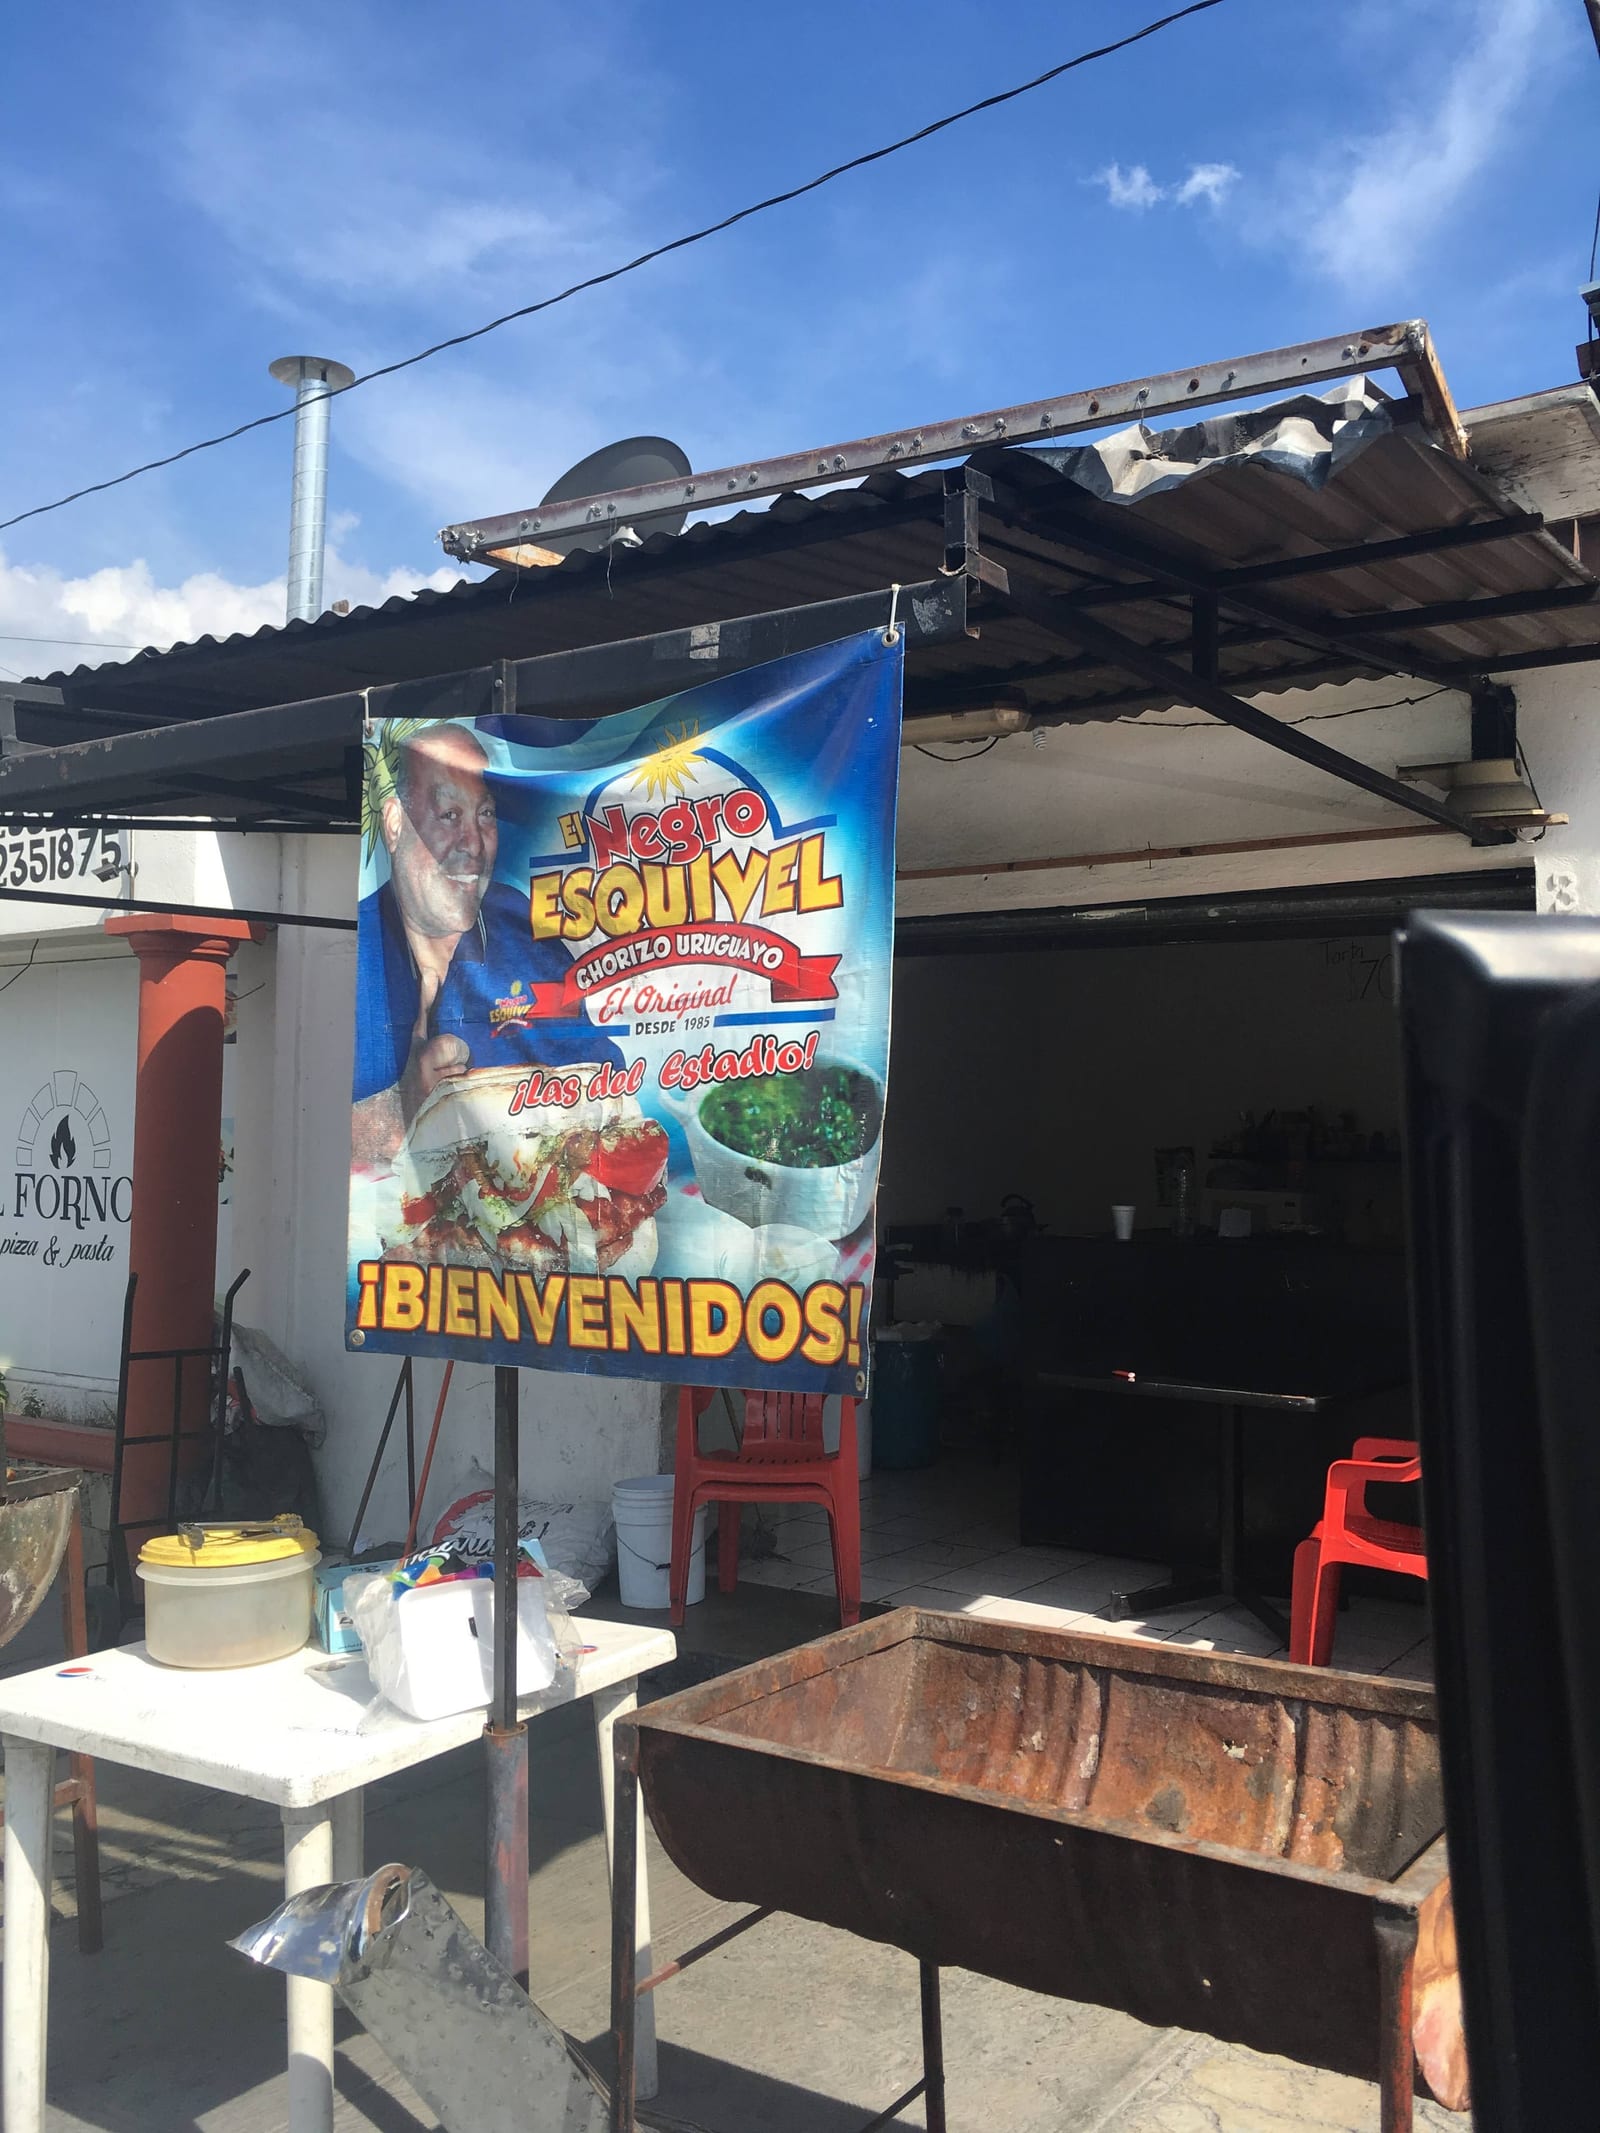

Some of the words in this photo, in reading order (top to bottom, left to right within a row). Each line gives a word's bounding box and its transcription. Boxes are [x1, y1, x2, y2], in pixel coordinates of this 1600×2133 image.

[558, 811, 586, 848] El
[585, 788, 769, 873] Negro
[530, 832, 843, 942] ESQUIVEL
[576, 935, 671, 991] CHORIZO
[676, 933, 784, 970] URUGUAYO
[599, 988, 626, 1024] El
[634, 974, 738, 1020] Original
[635, 1021, 676, 1035] DESDE
[683, 1017, 711, 1032] 1985
[509, 1070, 582, 1116] ¡Las
[587, 1057, 646, 1102] del
[659, 1031, 820, 1091] Estadio!
[14, 1173, 133, 1230] FORNO
[0, 1232, 39, 1256] pizza
[43, 1236, 60, 1266] &
[60, 1234, 114, 1268] pasta
[357, 1260, 866, 1367] ¡BIENVENIDOS!
